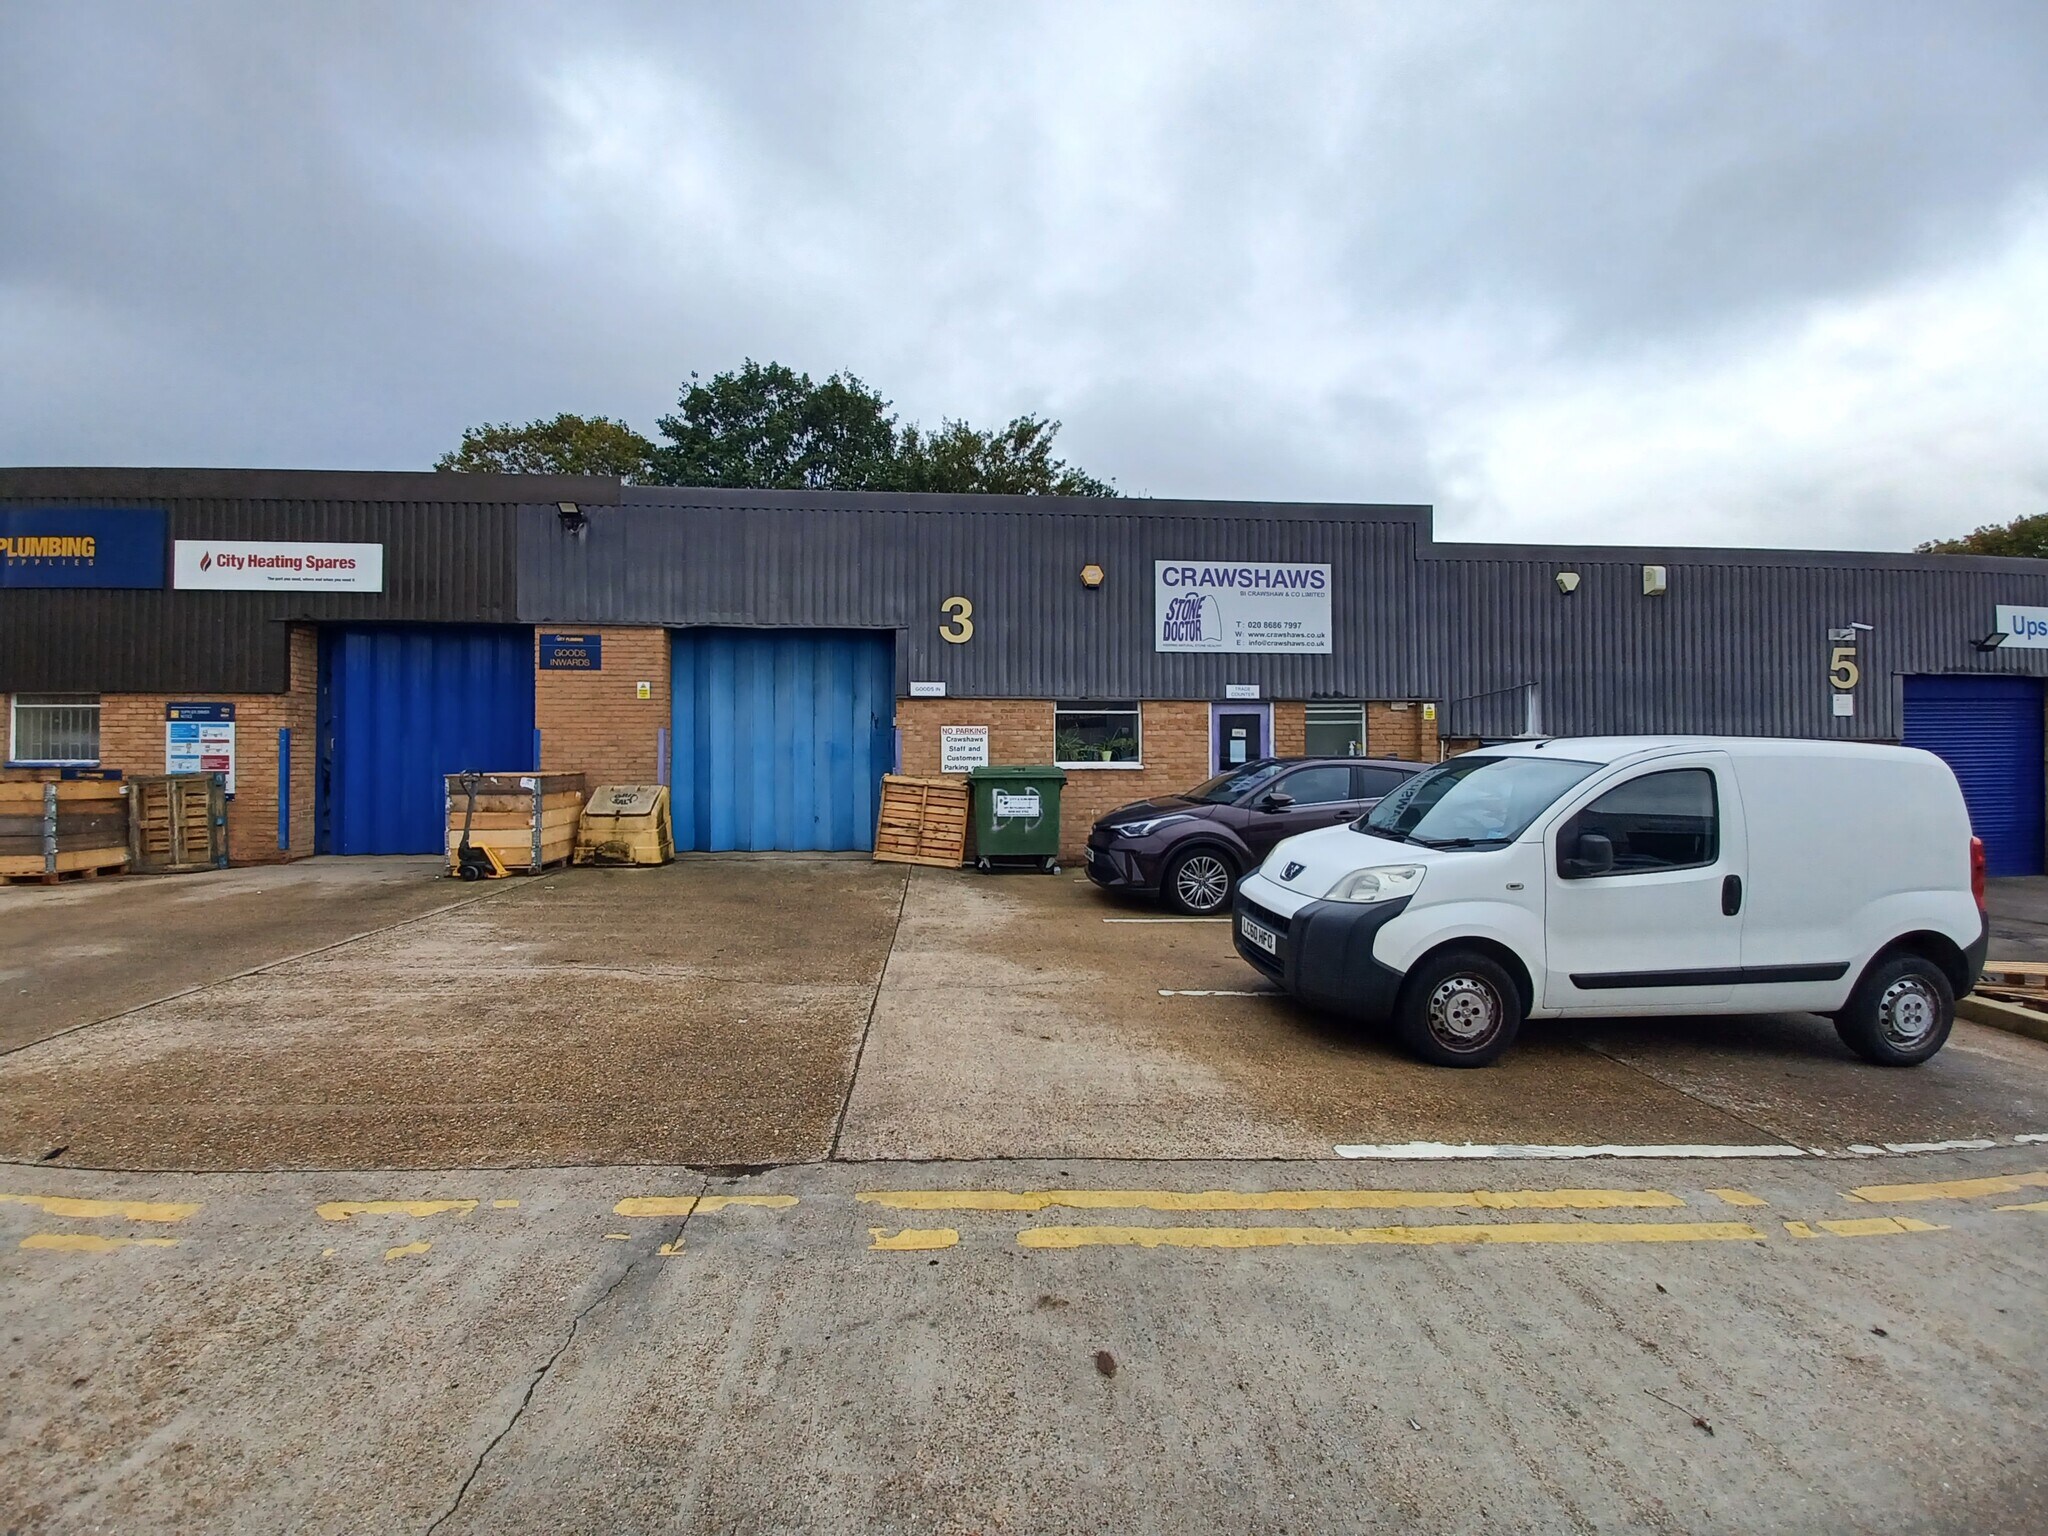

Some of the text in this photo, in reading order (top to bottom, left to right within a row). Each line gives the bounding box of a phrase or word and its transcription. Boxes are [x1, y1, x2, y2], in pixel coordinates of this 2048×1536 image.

[0, 536, 95, 557] PLUMBING
[216, 554, 356, 571] City Heating Spares
[1162, 567, 1325, 589] CRAWSHAWS
[1166, 595, 1206, 620] STONE
[939, 596, 974, 644] 3
[1163, 619, 1202, 642] DOCTOR
[2012, 615, 2048, 640] Ups
[550, 658, 590, 666] INWARDS
[554, 649, 587, 657] GOODS
[1829, 647, 1859, 689] 5
